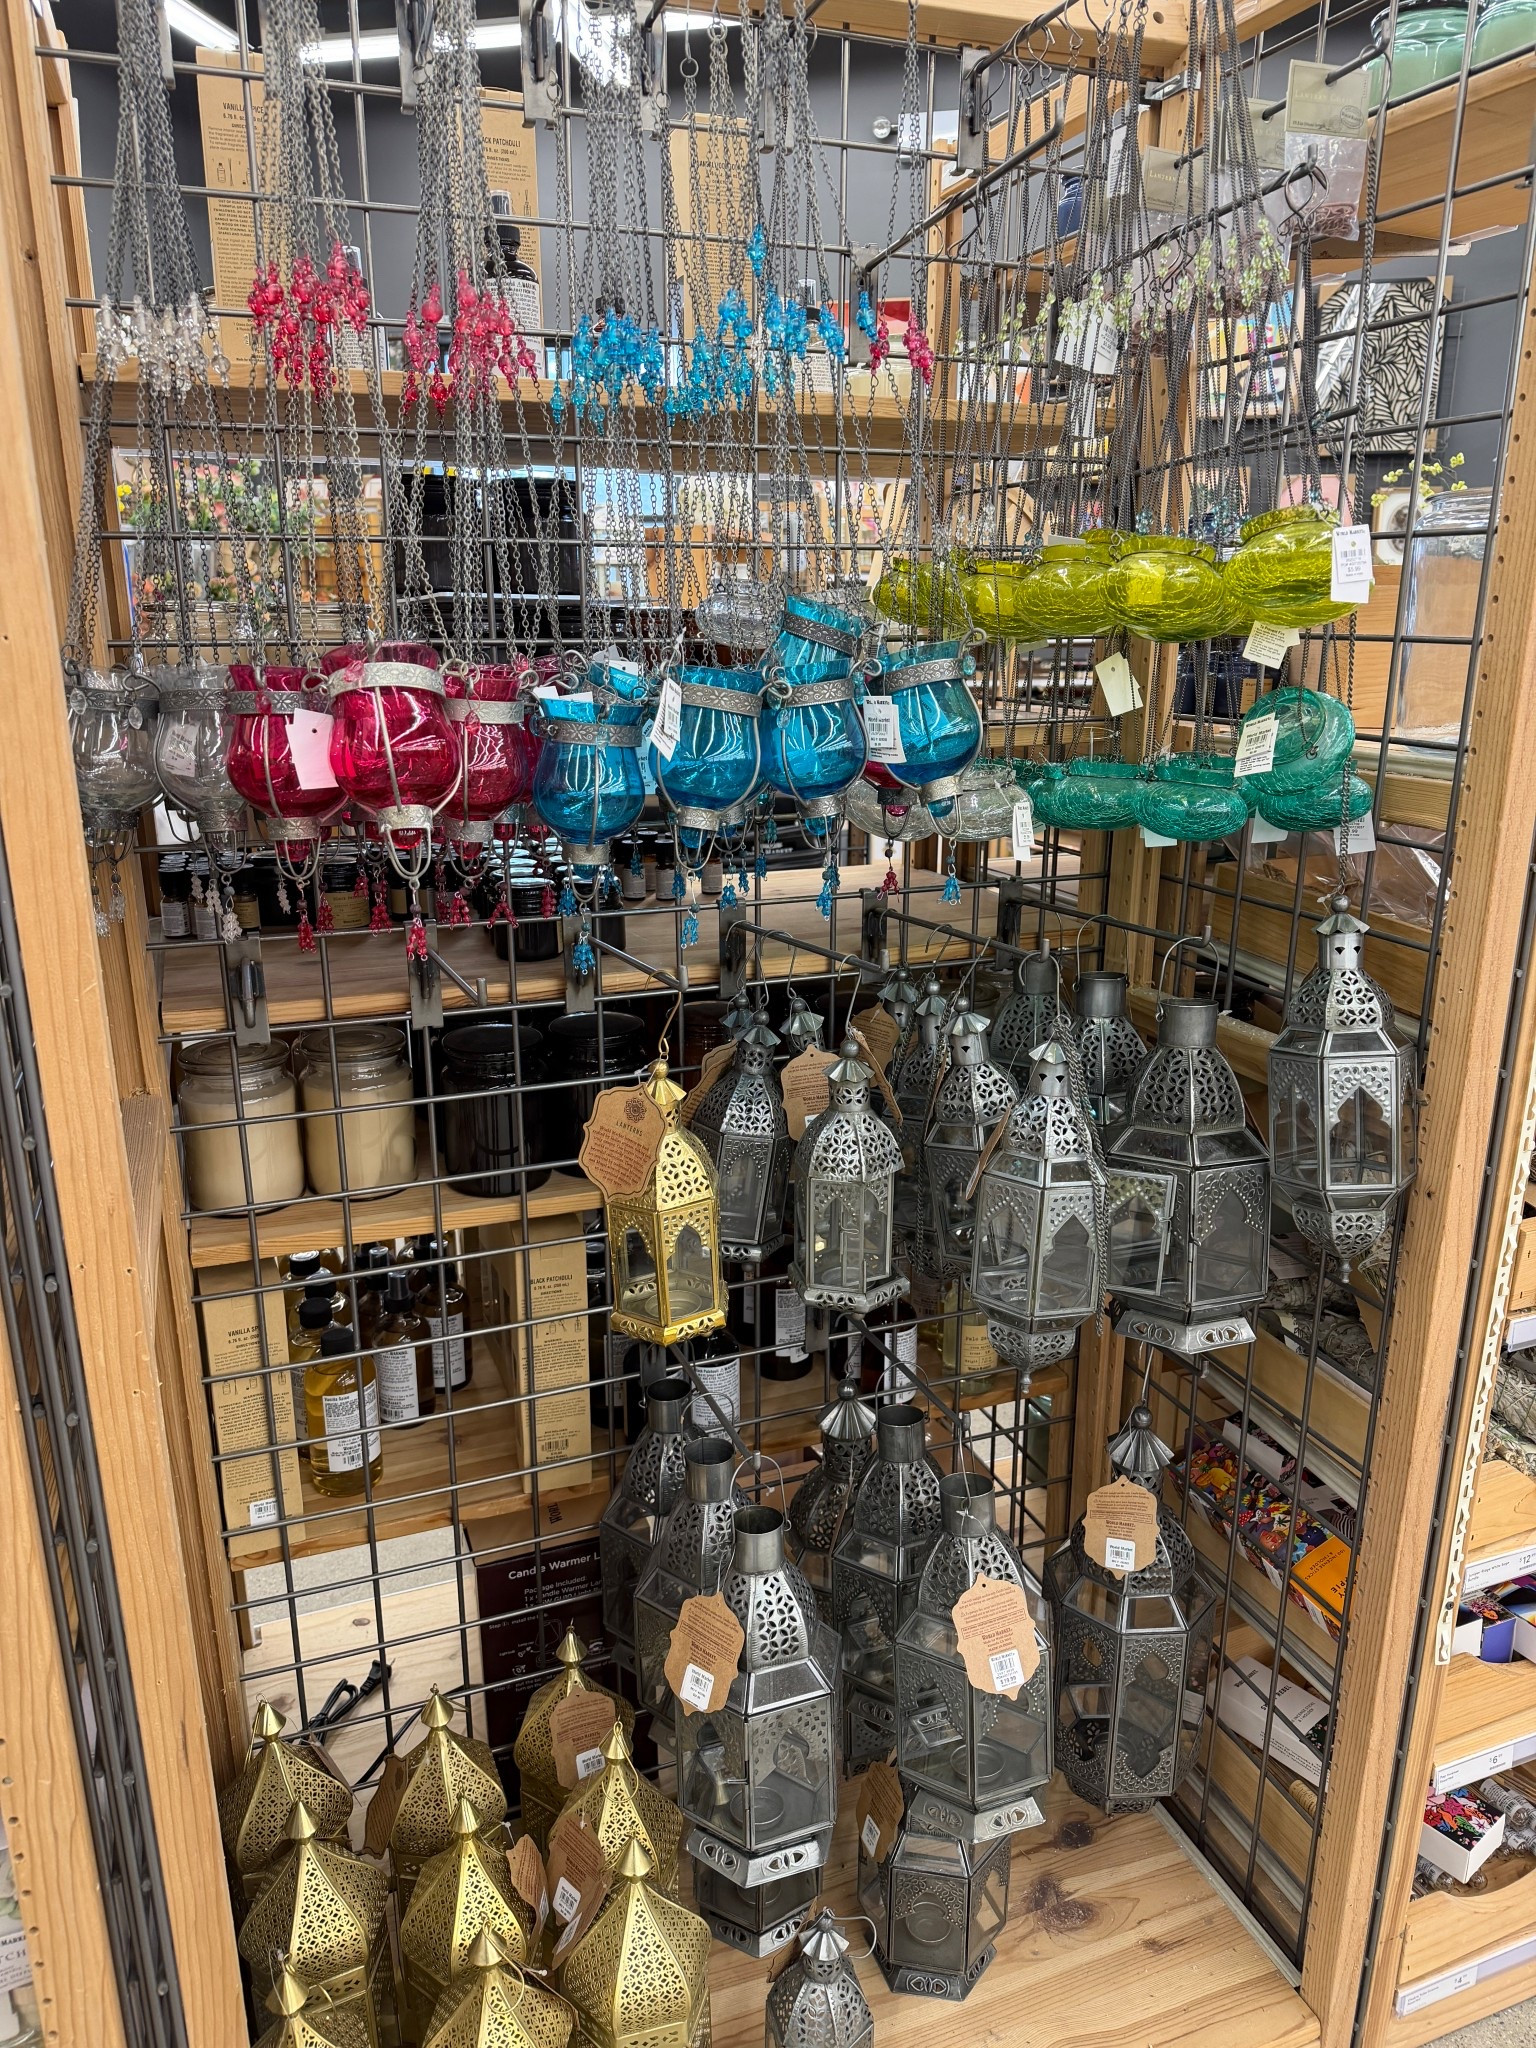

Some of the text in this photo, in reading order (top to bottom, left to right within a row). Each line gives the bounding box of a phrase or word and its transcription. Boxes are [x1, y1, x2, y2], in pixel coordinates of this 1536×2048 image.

[493, 138, 521, 148] PATCHOULI
[616, 1120, 643, 1136] LANTERNS
[546, 1274, 572, 1282] PATCHOULI
[228, 1328, 250, 1337] VANILLA
[508, 1554, 590, 1580] Cande Warmer
[524, 1584, 554, 1594] Pacage
[561, 1584, 589, 1593] Warmer
[1276, 1684, 1291, 1697] REBEL
